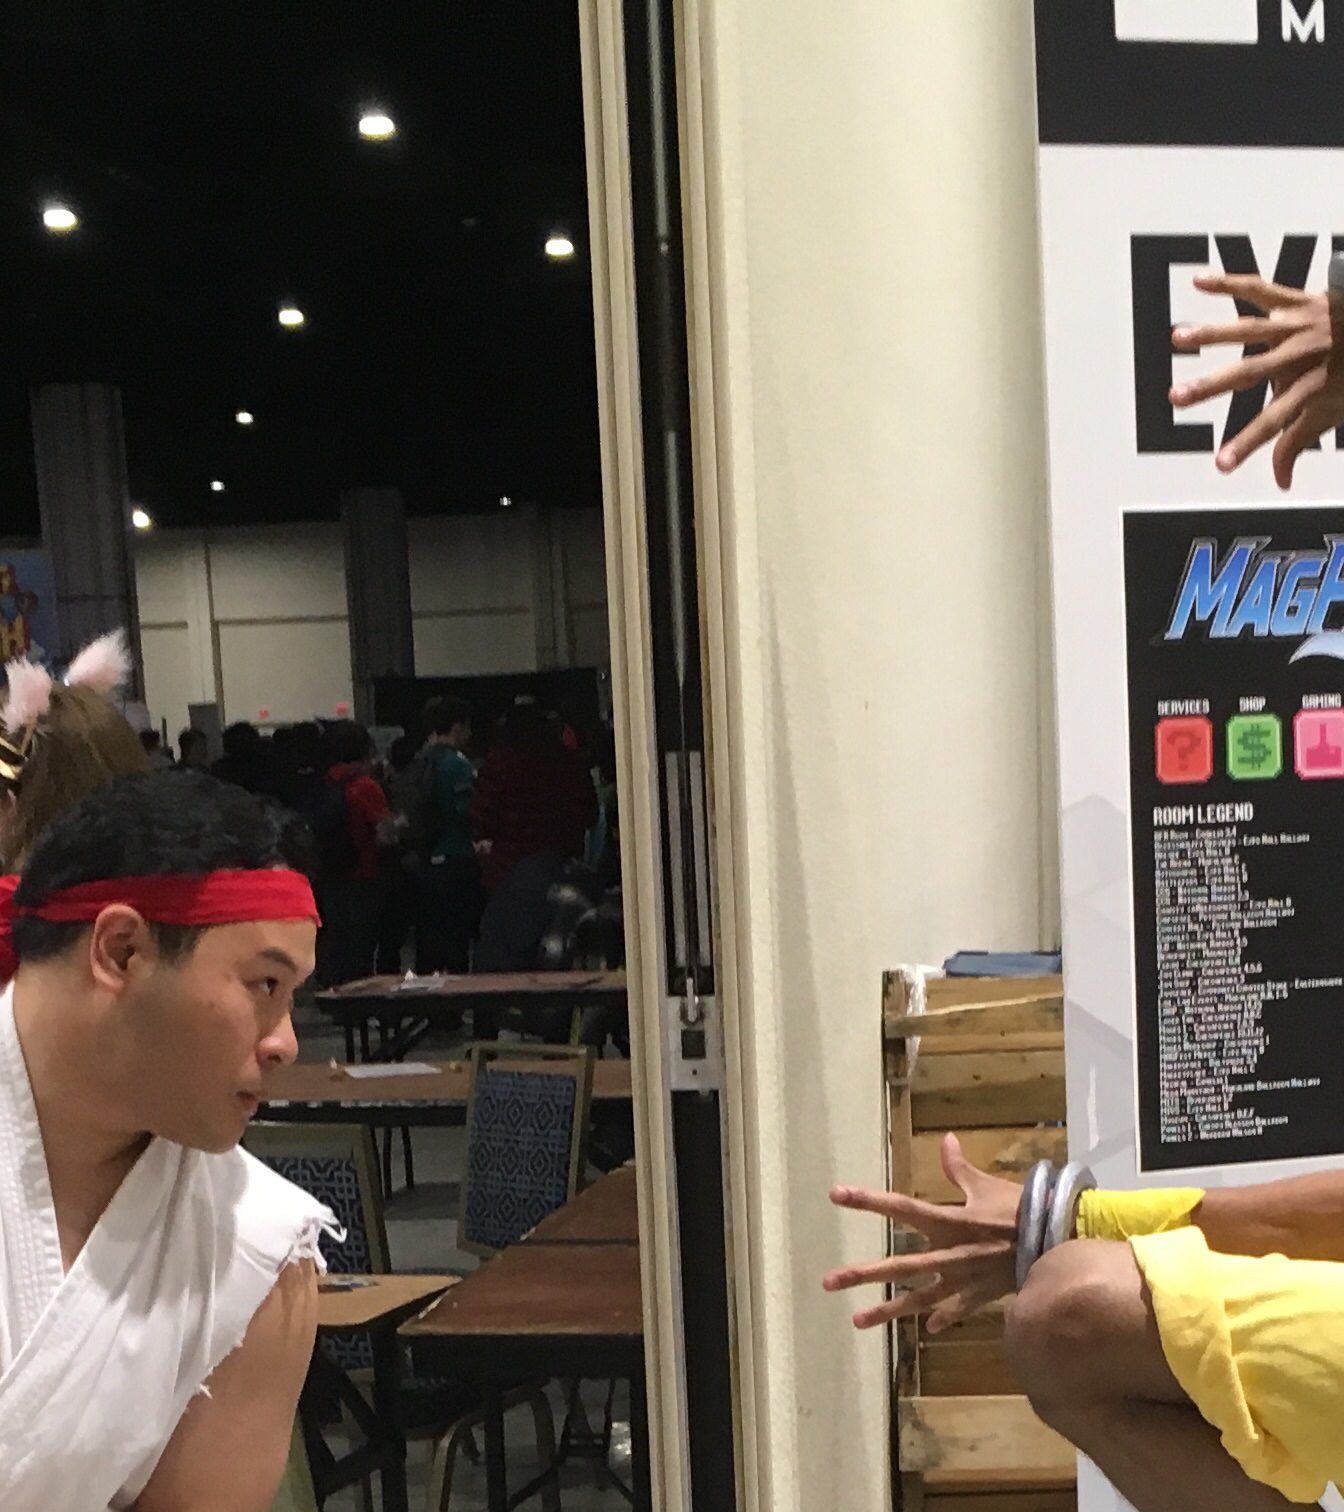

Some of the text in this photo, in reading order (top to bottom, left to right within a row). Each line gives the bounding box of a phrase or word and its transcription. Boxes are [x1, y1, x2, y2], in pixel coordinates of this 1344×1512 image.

[1157, 698, 1210, 716] SERVICES
[1239, 696, 1266, 712] SHOP
[1301, 693, 1342, 708] GAMING
[1152, 801, 1254, 826] ROOM LEGEND
